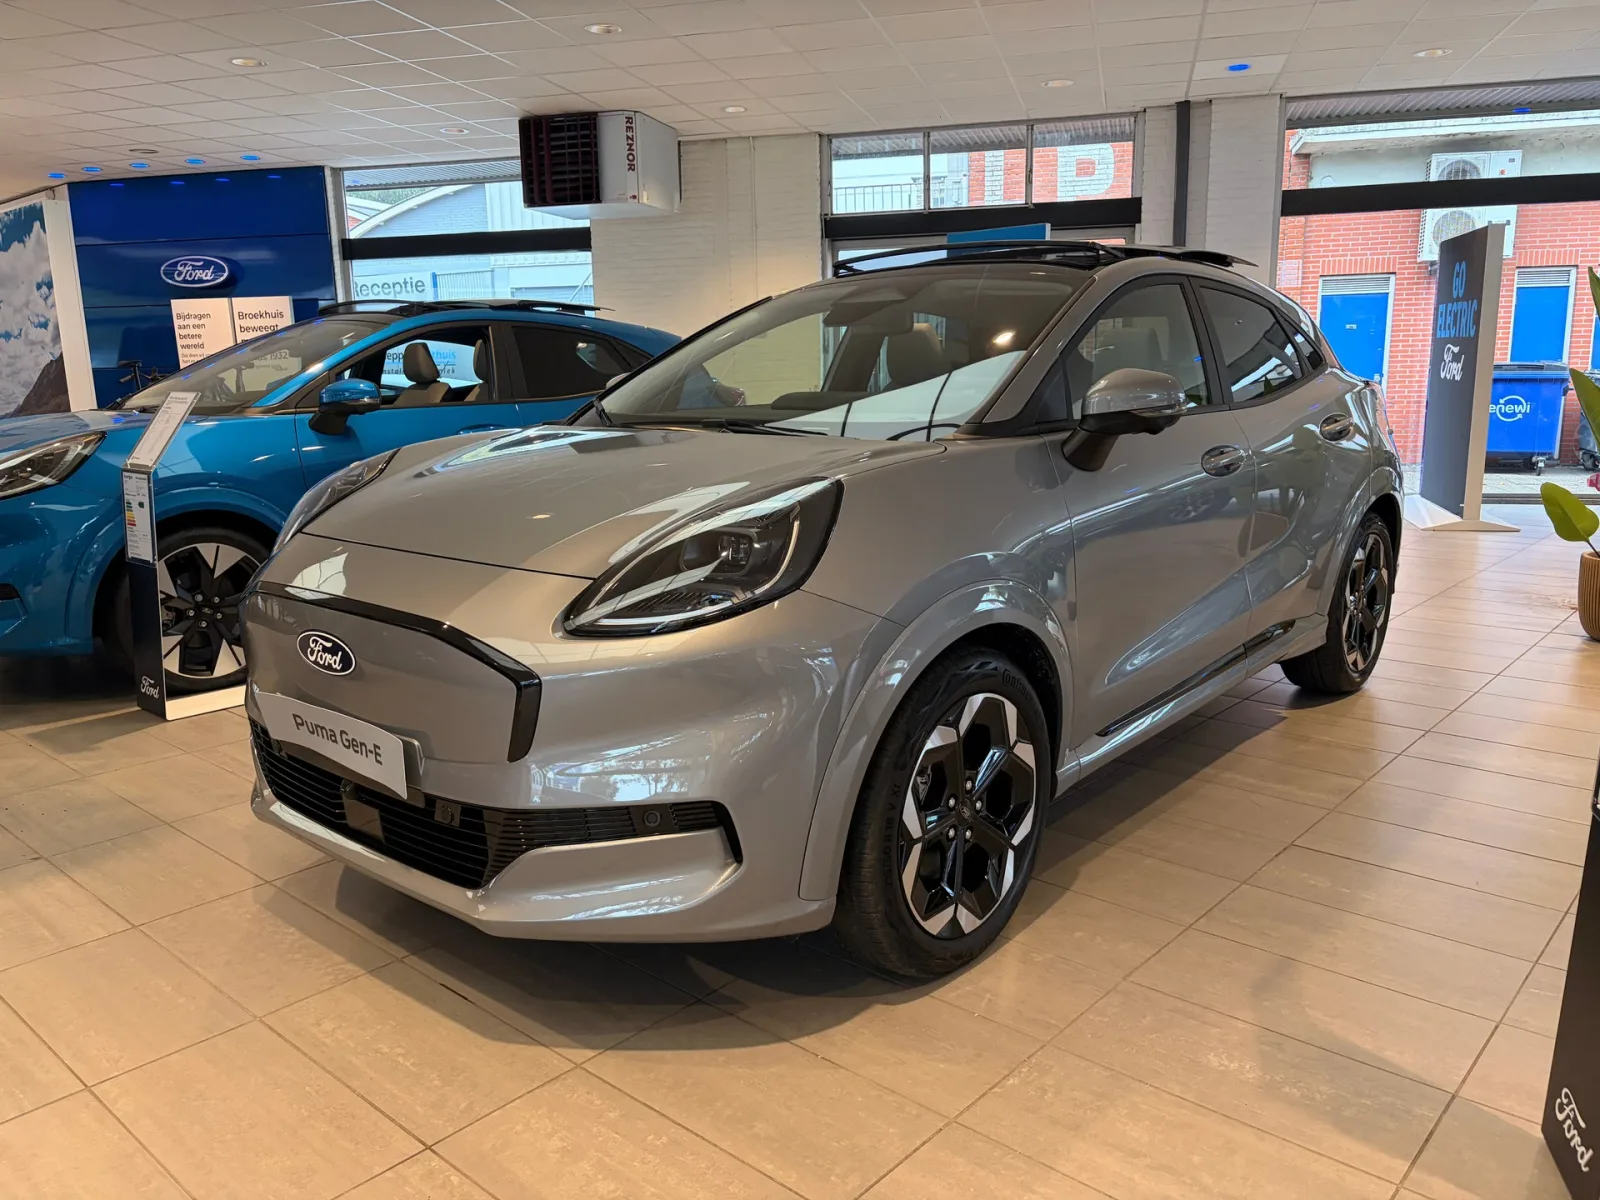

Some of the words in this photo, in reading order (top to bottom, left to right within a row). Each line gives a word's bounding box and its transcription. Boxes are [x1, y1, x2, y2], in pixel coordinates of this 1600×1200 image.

[624, 115, 636, 172] REZNOR
[174, 260, 215, 282] Ford
[1452, 260, 1466, 298] GO
[176, 312, 211, 321] Bijdragen
[238, 310, 284, 320] Broekhuis
[1436, 299, 1478, 338] ELECTRIC
[180, 342, 205, 350] wereld
[1440, 343, 1465, 382] Ford
[1488, 401, 1531, 415] enewi
[307, 636, 343, 670] Ford
[140, 675, 160, 699] Ford
[291, 713, 338, 745] Puma
[339, 729, 383, 766] Gen-E
[1555, 1087, 1594, 1172] Ford
